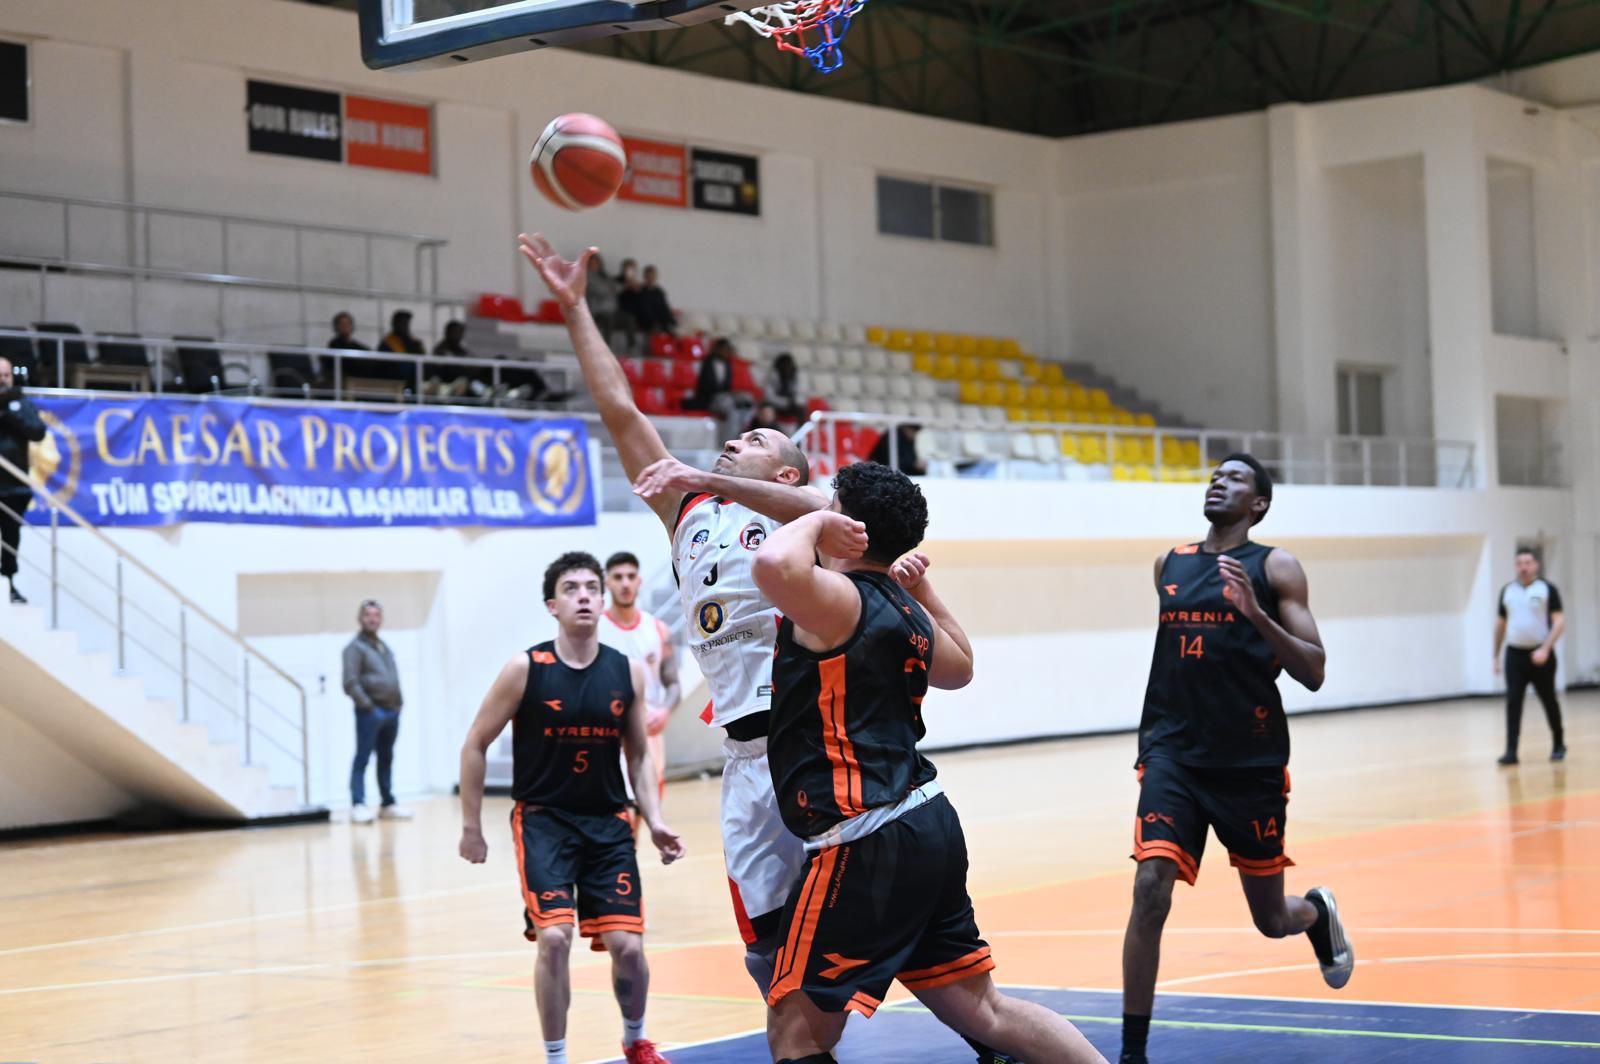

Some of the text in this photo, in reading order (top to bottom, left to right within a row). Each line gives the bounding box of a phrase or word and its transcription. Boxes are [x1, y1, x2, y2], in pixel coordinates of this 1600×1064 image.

[92, 477, 148, 516] TÜM
[1179, 635, 1204, 659] 14
[544, 727, 619, 737] KYRENIA
[573, 750, 589, 774] 5
[1251, 816, 1278, 841] 14
[615, 872, 633, 896] 5
